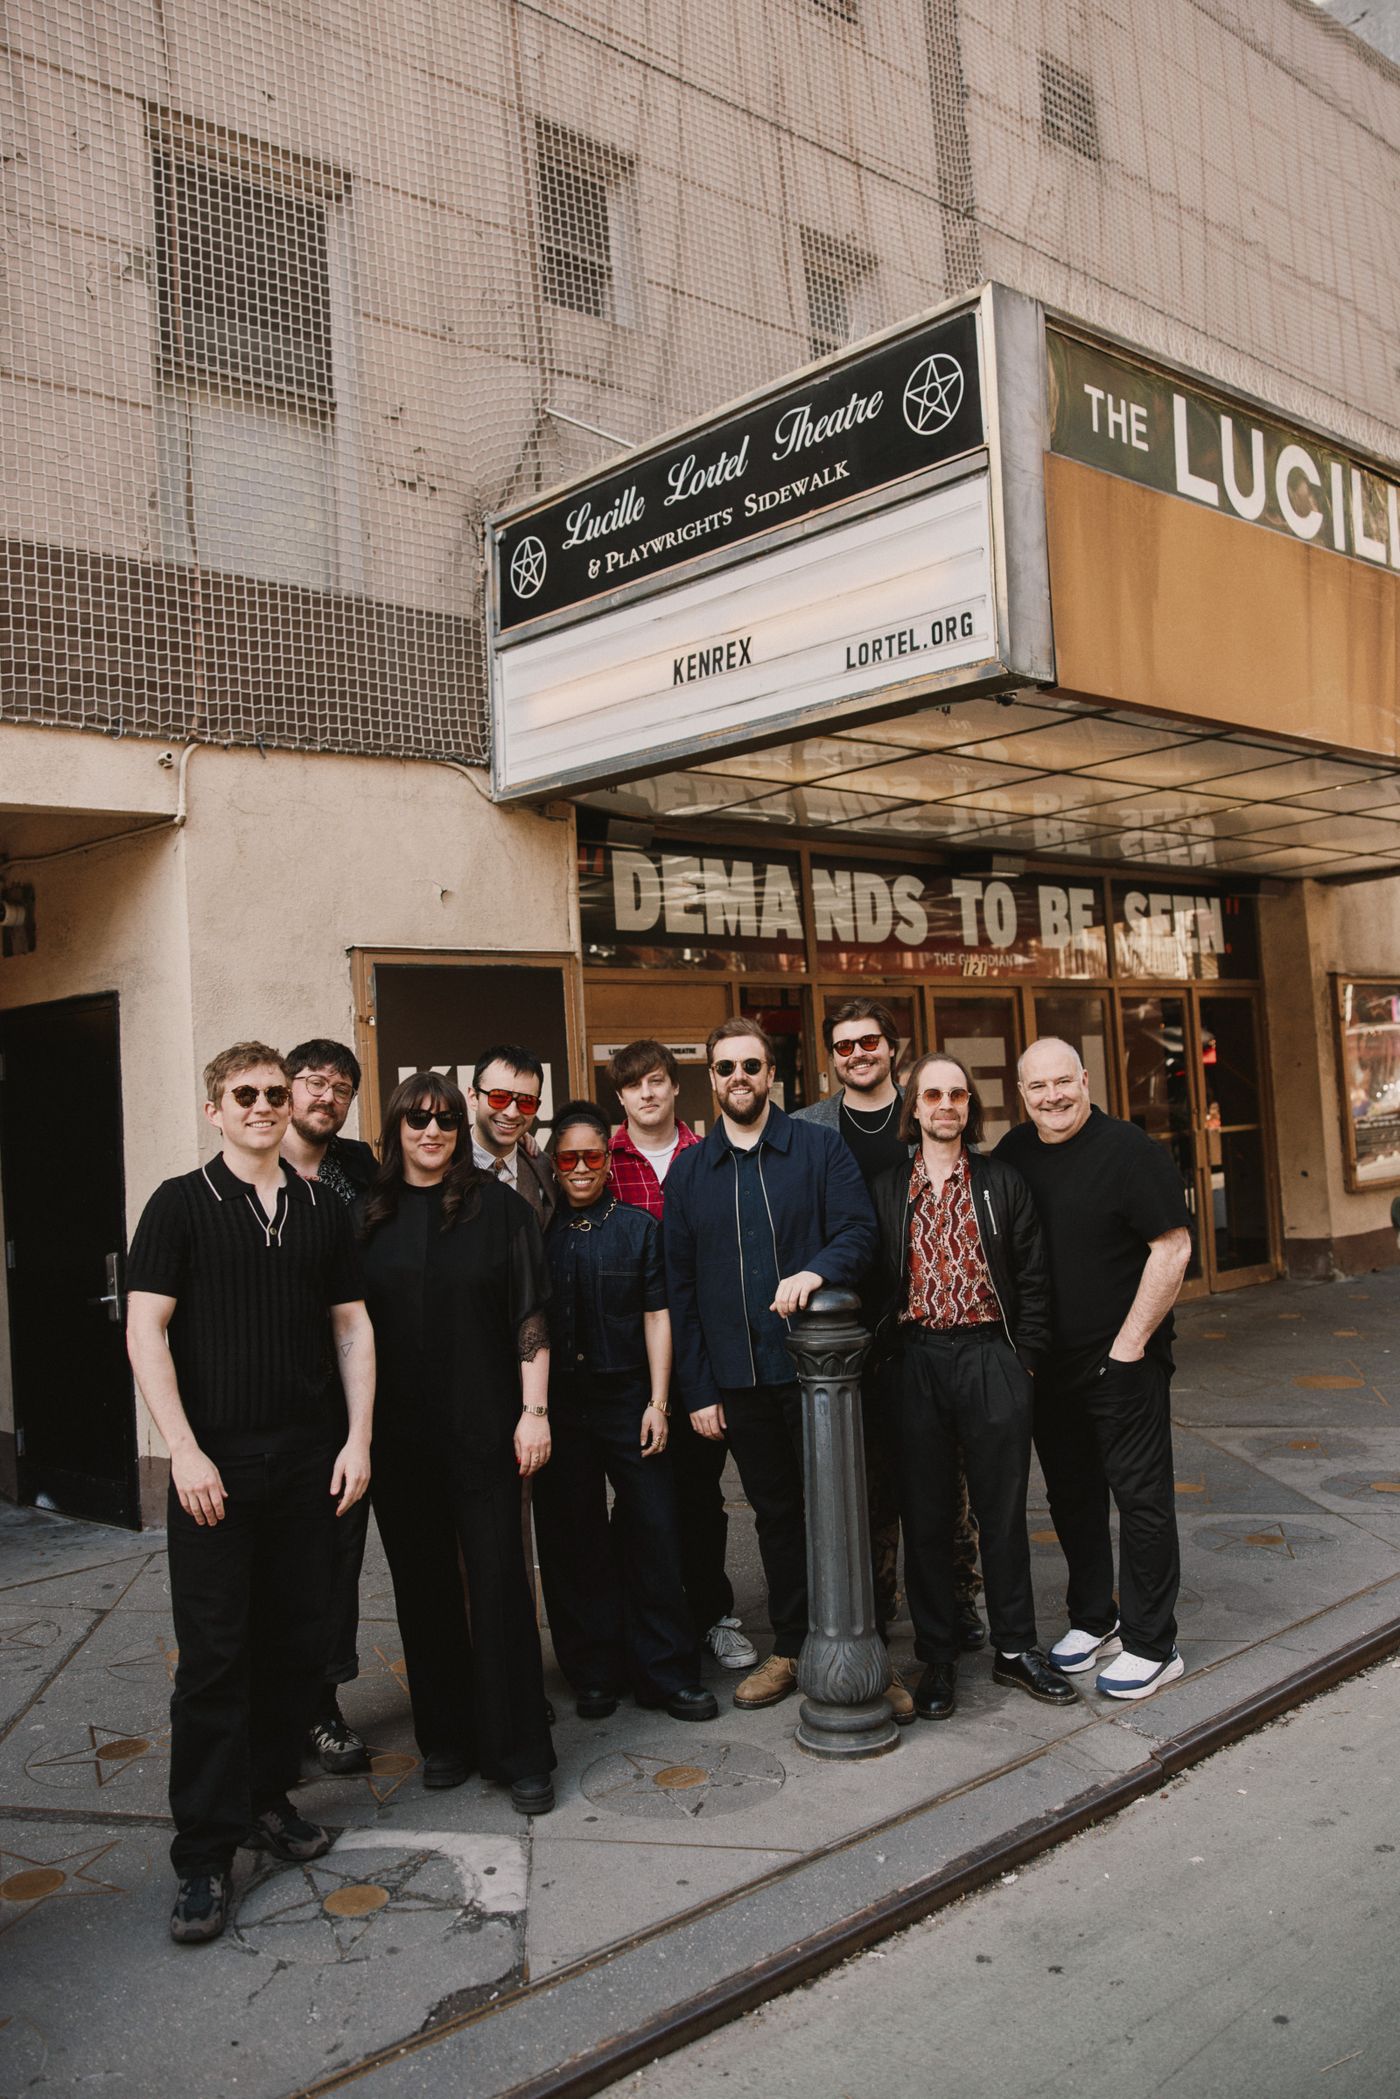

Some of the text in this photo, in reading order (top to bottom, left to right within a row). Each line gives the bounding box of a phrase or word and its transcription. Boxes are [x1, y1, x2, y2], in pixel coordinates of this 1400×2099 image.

[1083, 383, 1149, 452] THE
[562, 390, 884, 550] Lucille Lortel Theatre
[587, 558, 602, 579] &
[744, 460, 850, 518] SIDEWALK
[673, 611, 973, 686] KENREX LORTEL.ORG
[951, 878, 1017, 948] TO
[1038, 885, 1095, 949] BE
[934, 952, 956, 966] THE
[964, 960, 987, 976] 121
